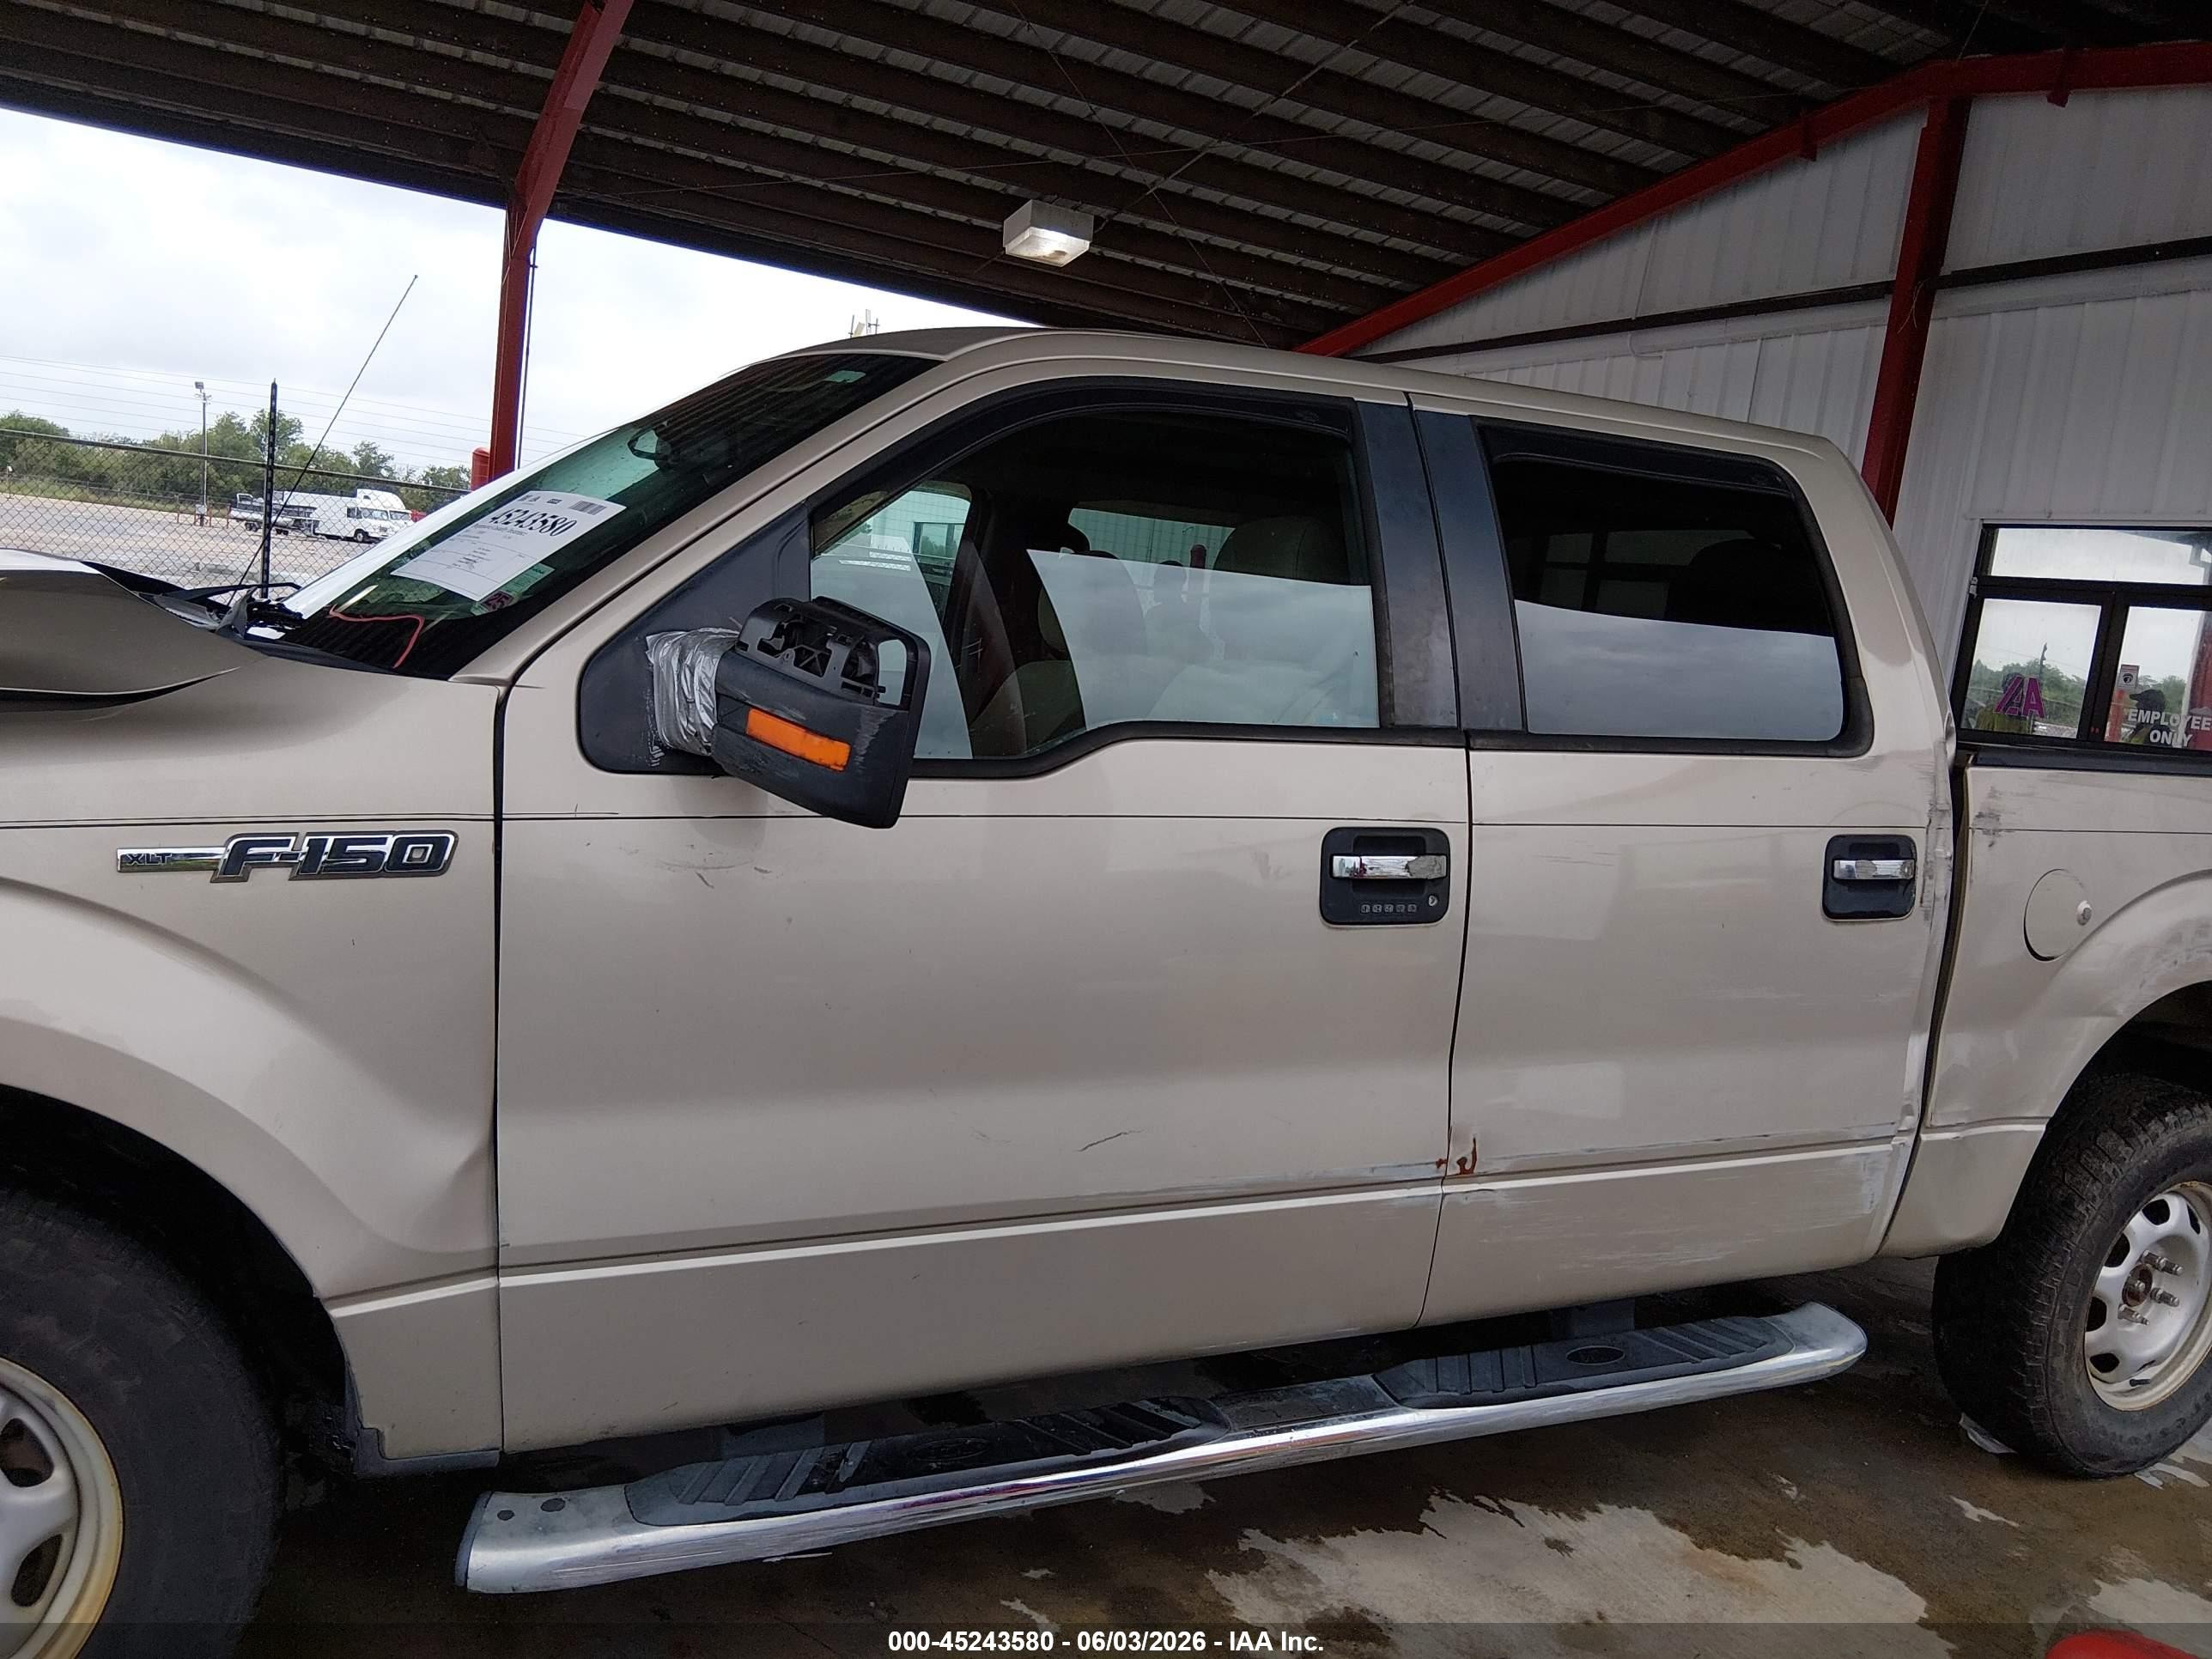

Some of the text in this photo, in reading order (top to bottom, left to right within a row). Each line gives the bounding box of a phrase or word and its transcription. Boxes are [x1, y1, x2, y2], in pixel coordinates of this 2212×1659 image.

[489, 508, 577, 537] 45243580
[2149, 729, 2192, 748] ONLY
[125, 853, 172, 866] XLT
[211, 830, 459, 883] F-150
